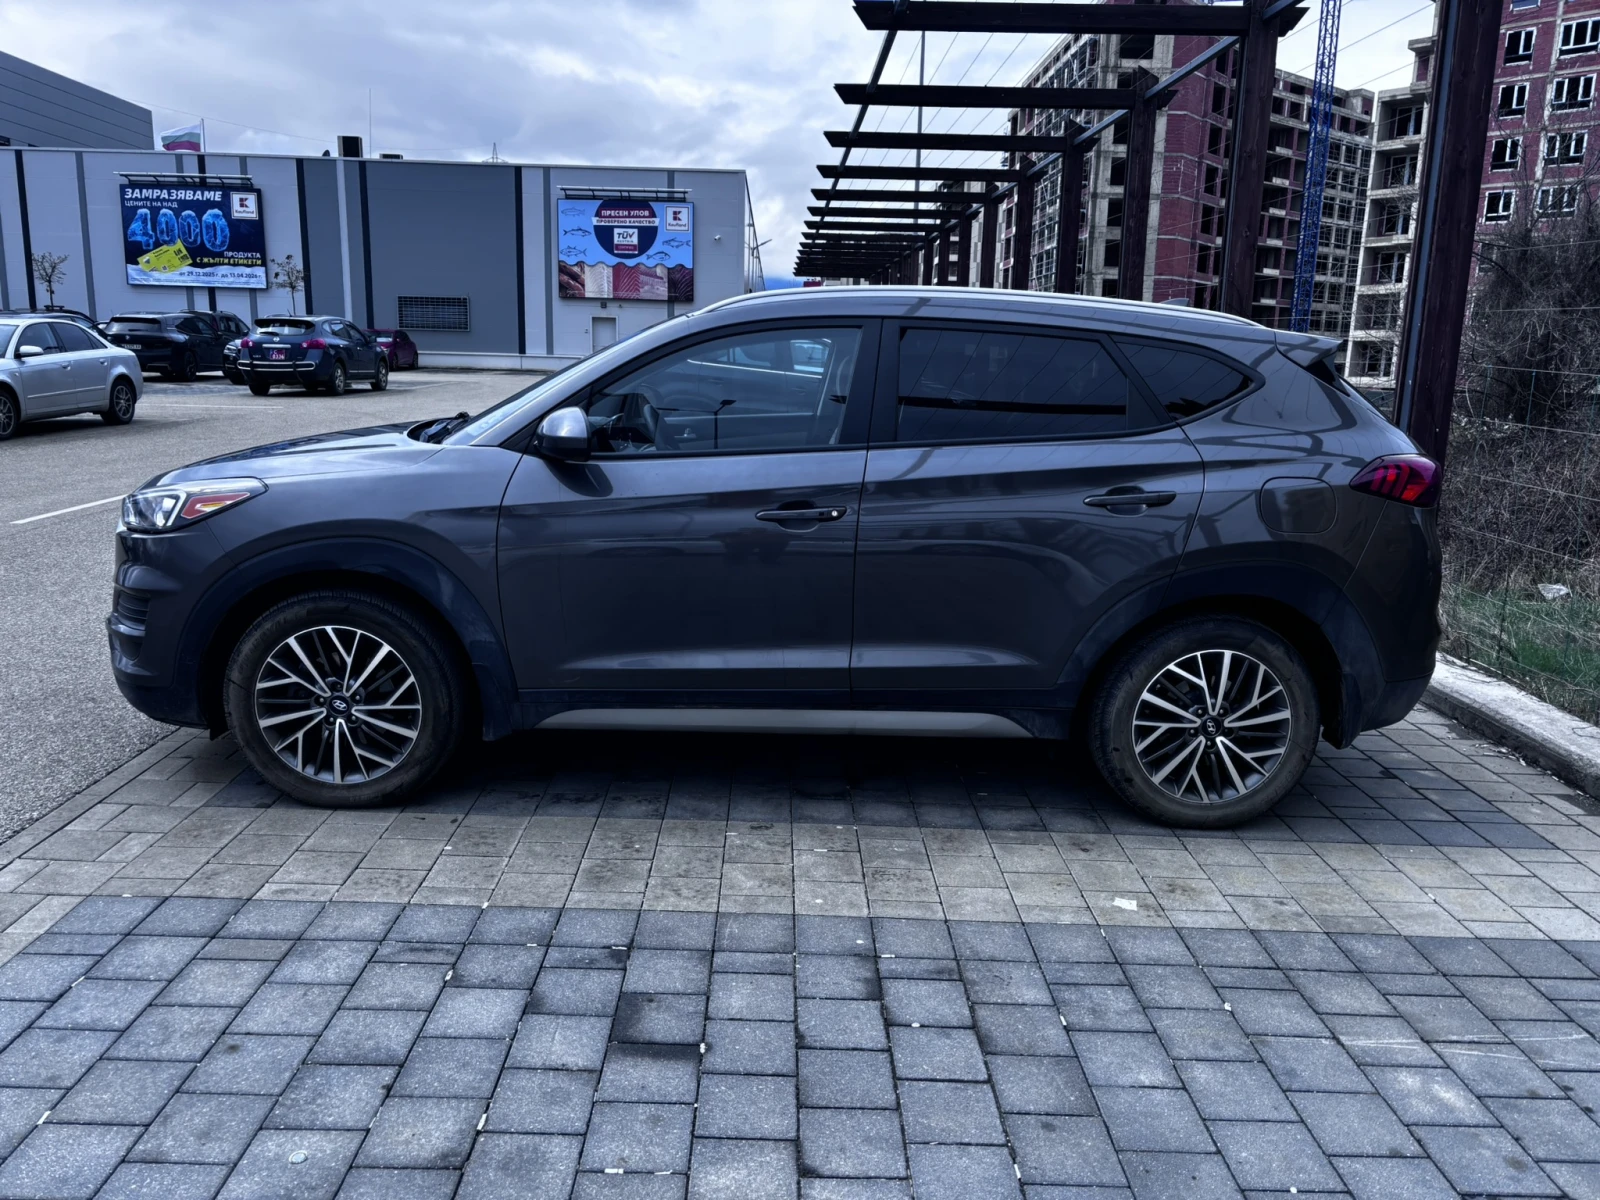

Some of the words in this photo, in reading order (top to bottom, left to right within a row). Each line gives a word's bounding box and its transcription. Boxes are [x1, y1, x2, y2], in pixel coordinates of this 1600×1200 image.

[124, 188, 222, 201] ЗАМРАЗЯВАМЕ
[127, 208, 230, 252] 4000
[616, 231, 635, 240] TÜV
